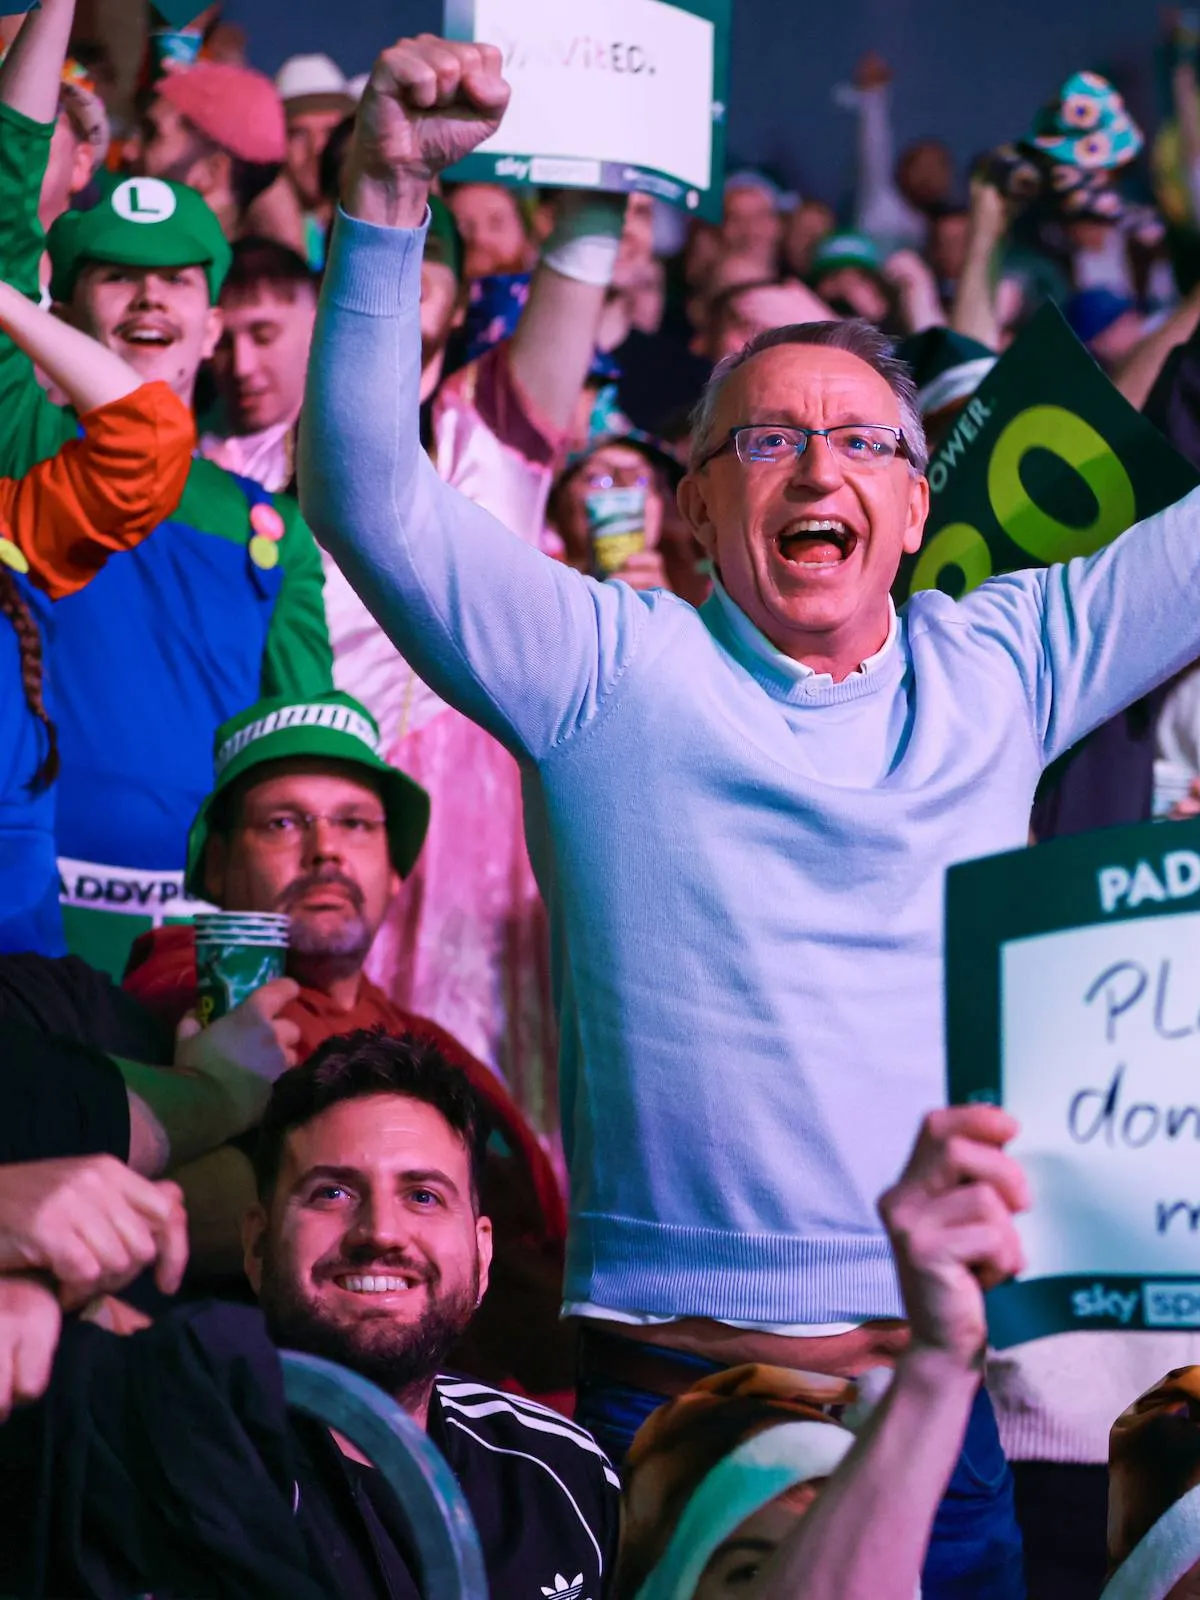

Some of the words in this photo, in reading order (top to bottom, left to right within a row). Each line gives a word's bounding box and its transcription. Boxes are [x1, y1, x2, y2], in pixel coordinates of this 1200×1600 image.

[129, 186, 160, 214] L
[928, 396, 992, 494] OWER
[1070, 1283, 1138, 1324] sky
